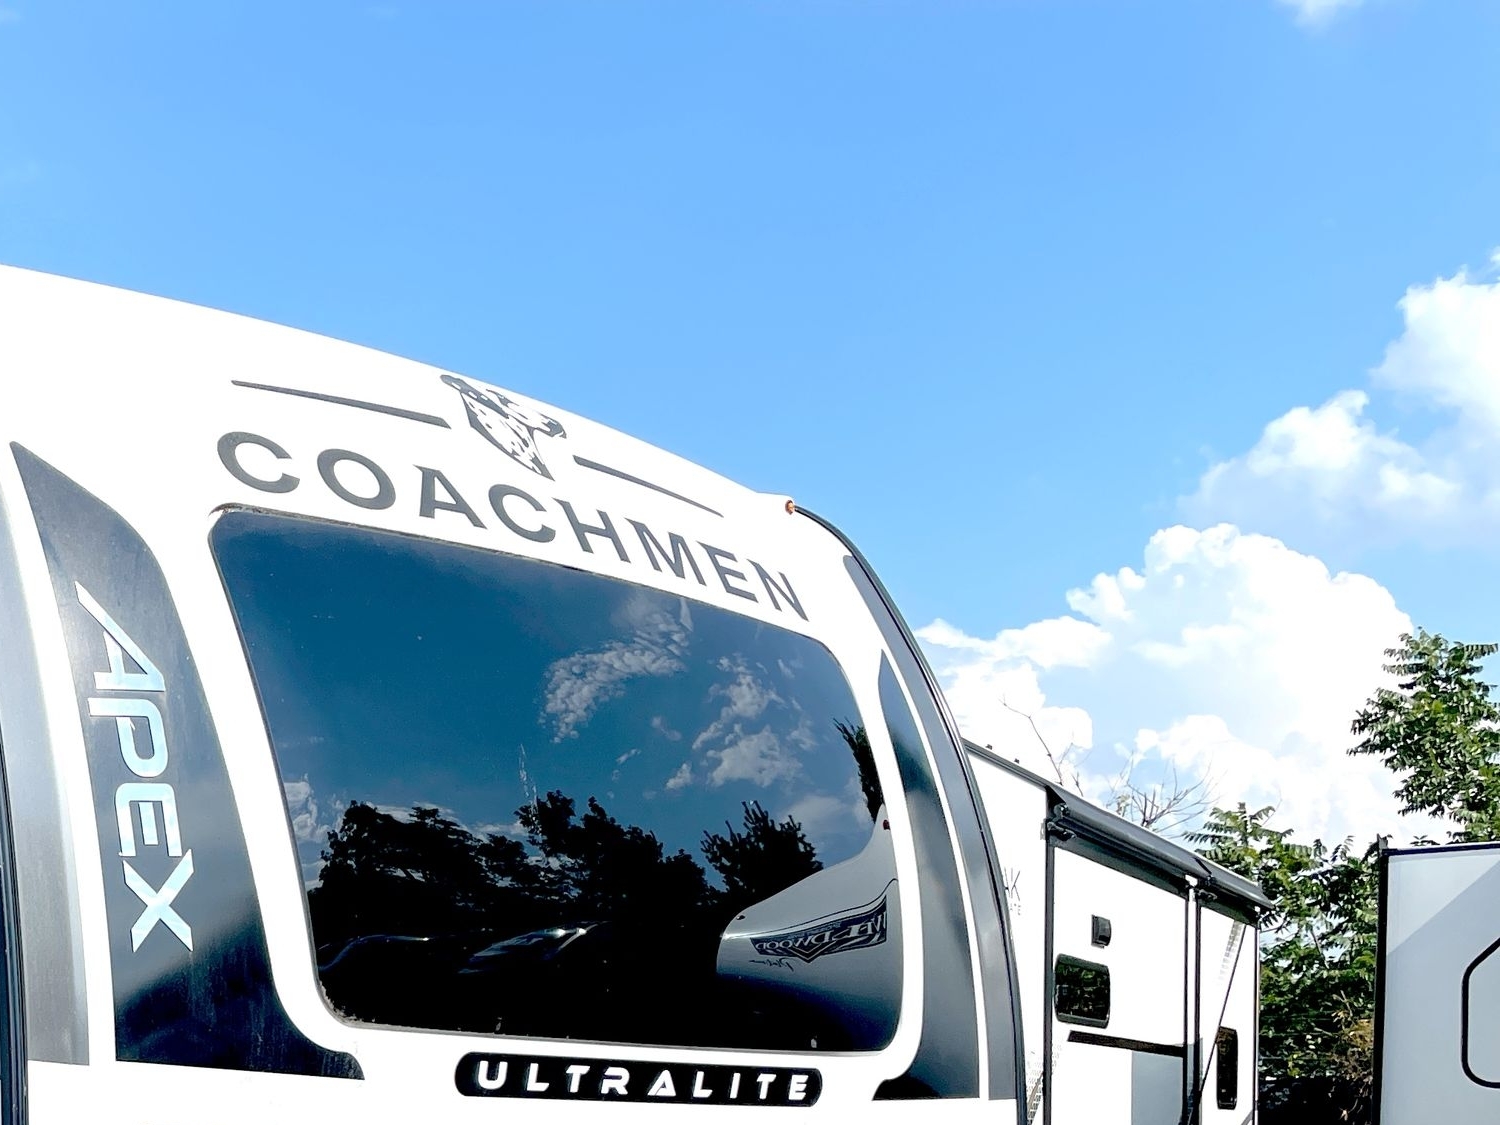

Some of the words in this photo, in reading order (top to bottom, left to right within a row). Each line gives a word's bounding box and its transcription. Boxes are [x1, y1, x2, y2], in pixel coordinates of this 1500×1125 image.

[217, 431, 809, 621] COACHMEN
[74, 580, 195, 953] APEX
[477, 1060, 809, 1101] ULTRALITE
